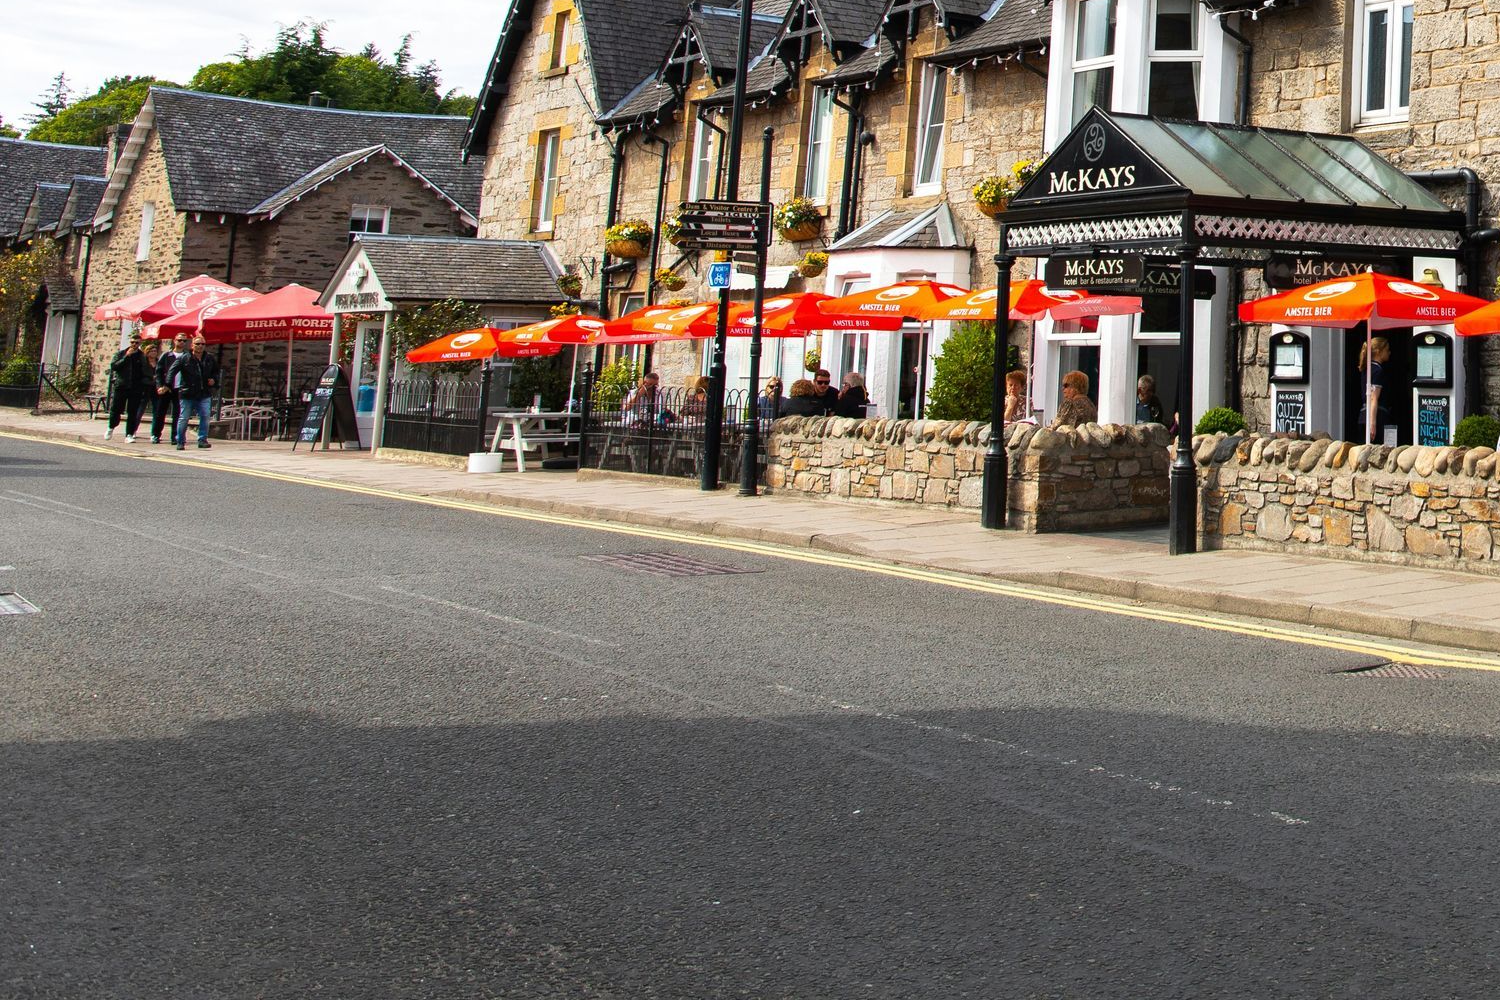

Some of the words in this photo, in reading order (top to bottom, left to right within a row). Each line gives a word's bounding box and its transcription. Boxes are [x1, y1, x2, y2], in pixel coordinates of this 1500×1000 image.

[1048, 165, 1135, 194] McKAYS
[1064, 259, 1124, 276] McKAYS
[1063, 278, 1078, 286] hotel
[1095, 277, 1124, 285] restaurant
[1143, 271, 1181, 286] KAY
[1293, 276, 1312, 285] hotel
[859, 304, 883, 312] AMSTEL
[884, 304, 900, 312] BIER
[1285, 307, 1312, 317] AMSTEL
[1314, 306, 1332, 316] BIER
[1416, 306, 1440, 316] AMSTEL
[1440, 307, 1457, 317] BIER
[245, 319, 287, 328] BIRRA
[291, 318, 334, 328] MORET
[832, 319, 854, 327] AMSTEL
[855, 319, 870, 327] BIER
[1277, 401, 1304, 419] QUIZ
[1420, 410, 1445, 425] STEAK
